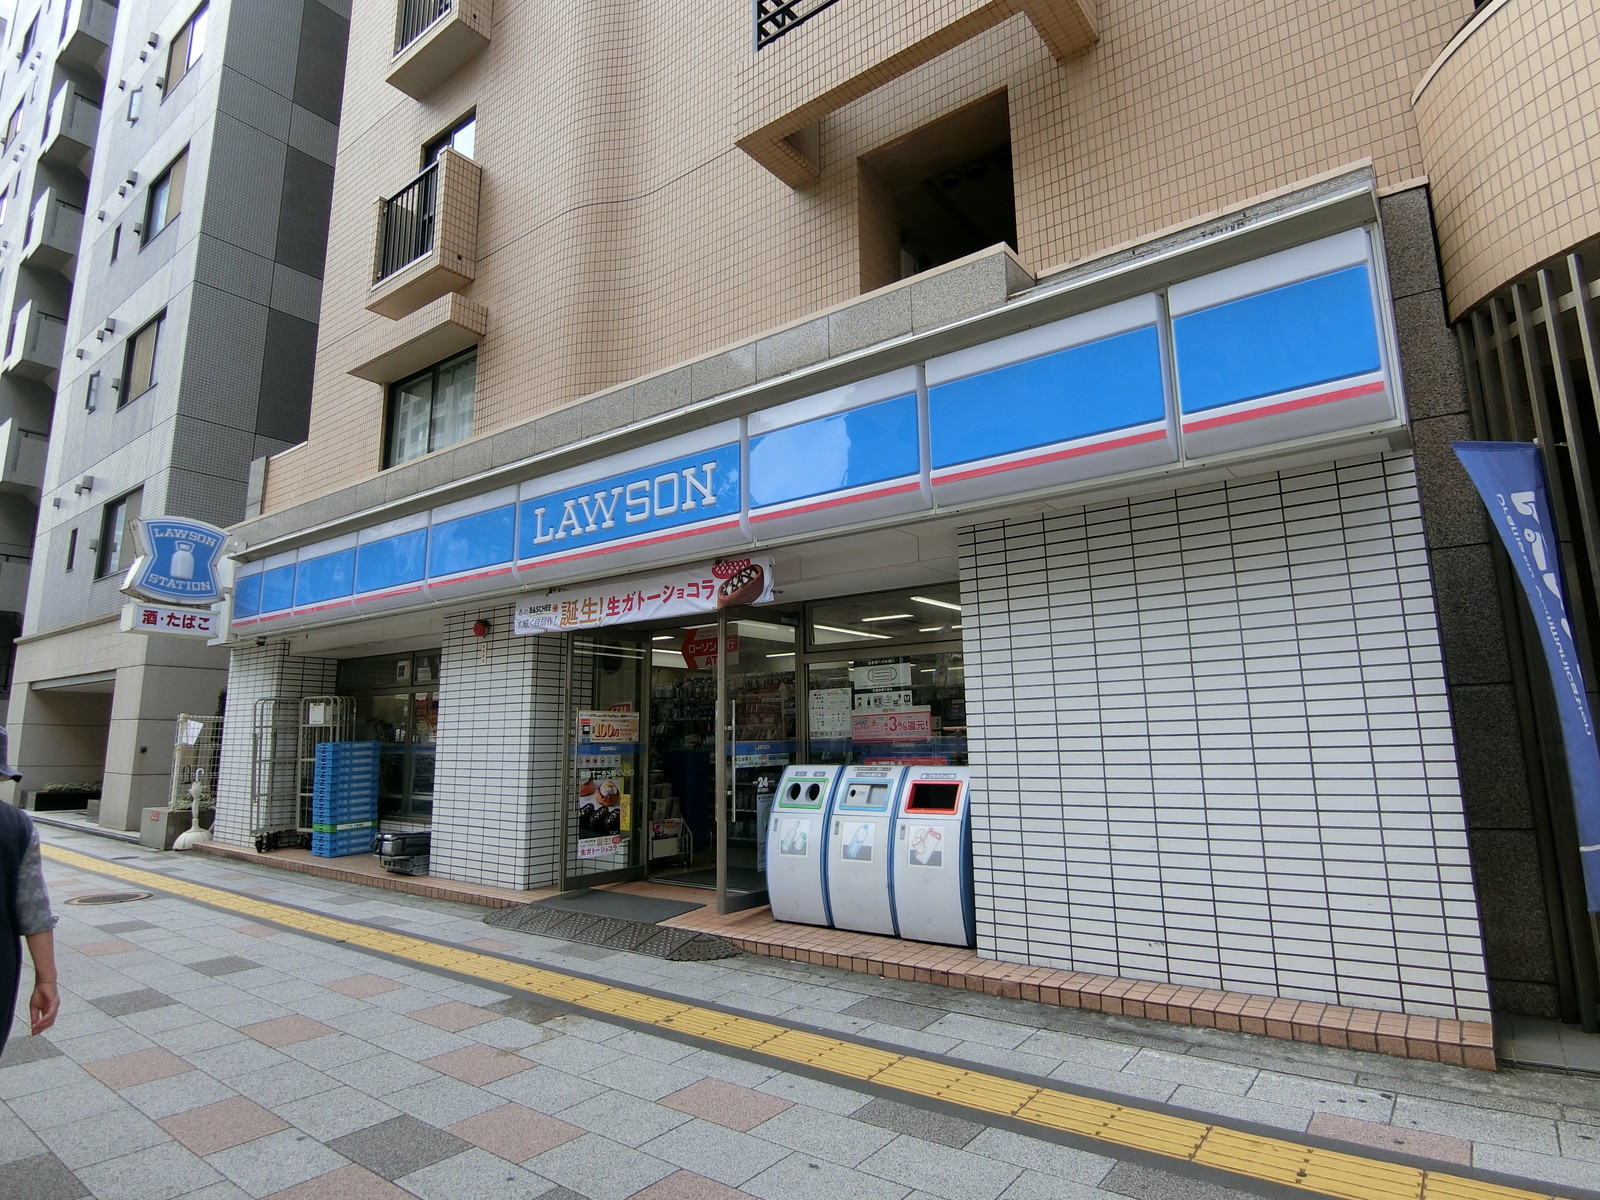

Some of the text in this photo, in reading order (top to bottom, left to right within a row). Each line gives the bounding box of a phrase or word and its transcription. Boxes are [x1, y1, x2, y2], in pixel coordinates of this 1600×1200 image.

[533, 460, 717, 545] LAWSON
[153, 528, 217, 547] LAWSON
[148, 573, 212, 591] STATION
[605, 579, 716, 617] 生ガトーショコラ
[142, 609, 211, 631] 酒・たばこ
[559, 596, 604, 627] 誕生!
[688, 638, 735, 654] ローソン行
[705, 655, 718, 667] AT
